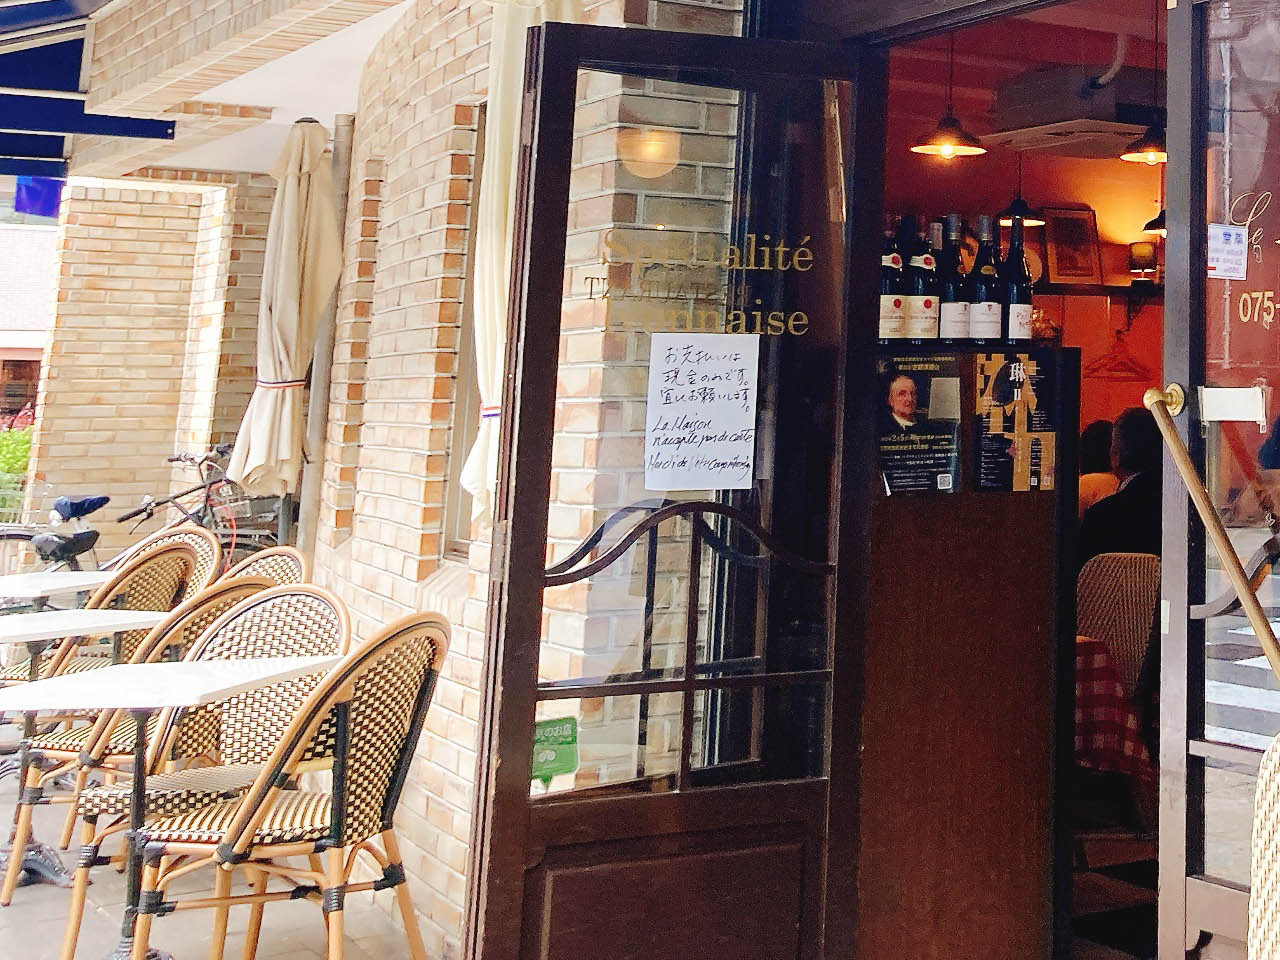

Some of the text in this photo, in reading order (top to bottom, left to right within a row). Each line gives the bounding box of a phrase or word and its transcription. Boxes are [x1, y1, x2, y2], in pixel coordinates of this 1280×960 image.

[1230, 191, 1272, 245] Le
[602, 228, 814, 273] Spalité
[665, 344, 742, 366] お支払いは
[661, 367, 749, 387] 現金のみです。
[671, 413, 713, 435] Maison
